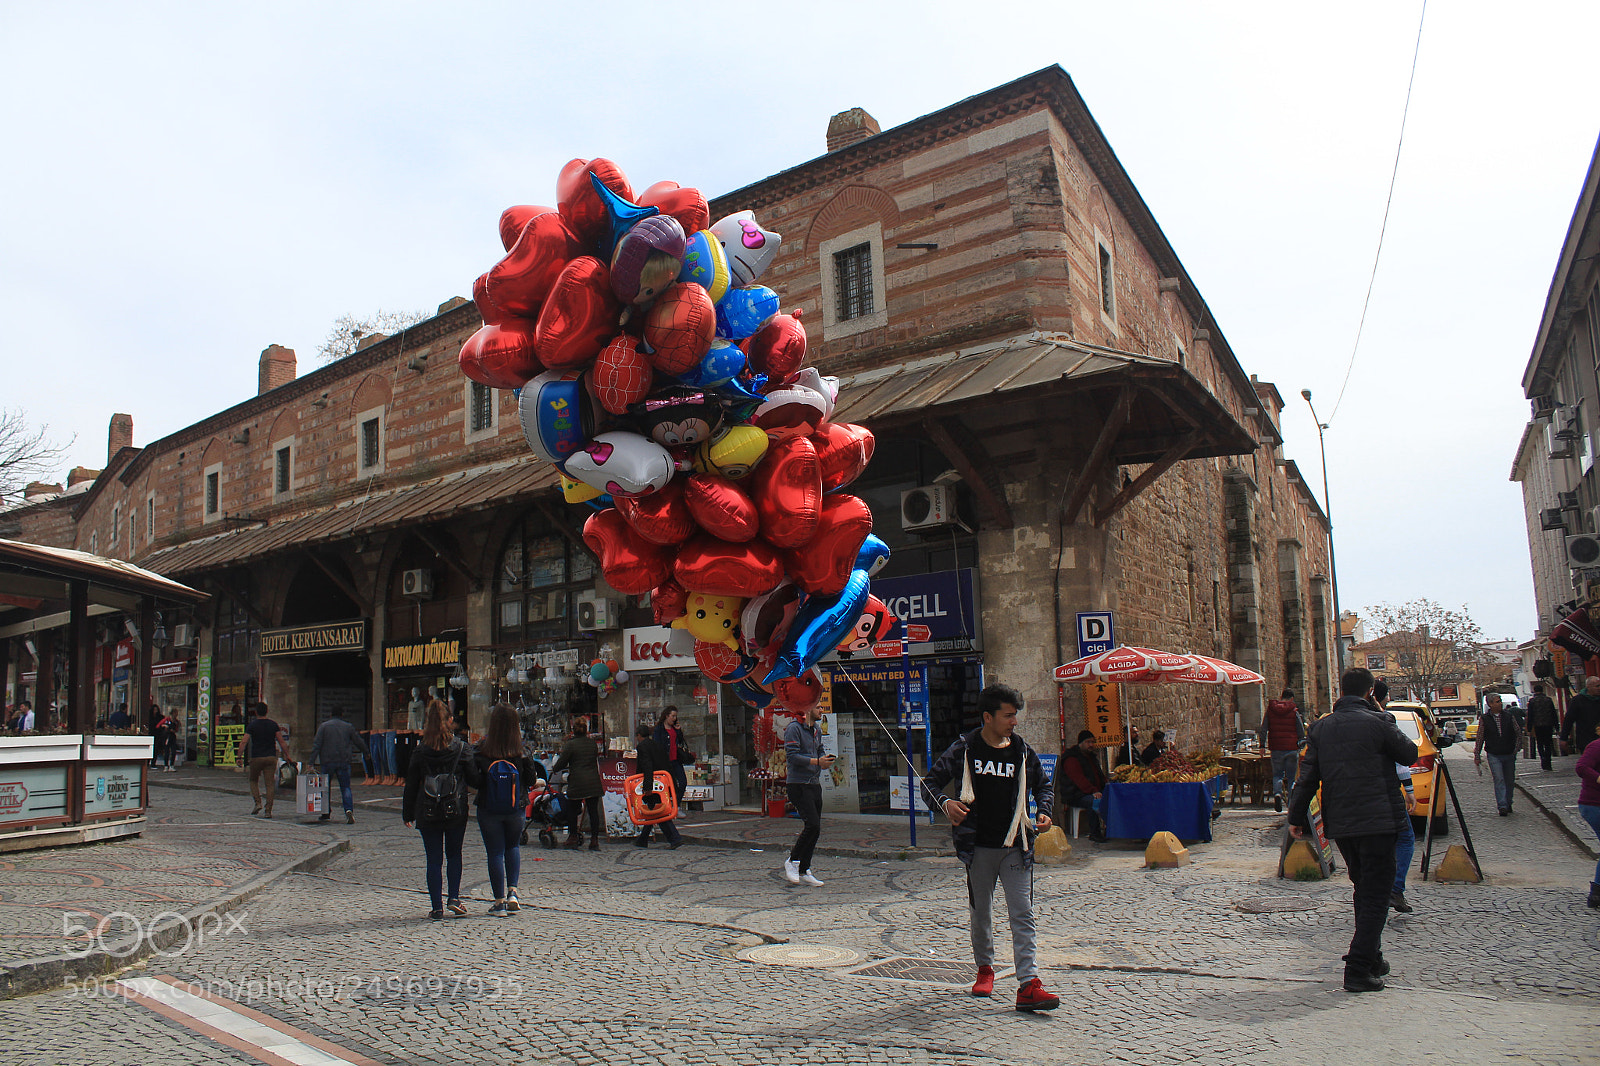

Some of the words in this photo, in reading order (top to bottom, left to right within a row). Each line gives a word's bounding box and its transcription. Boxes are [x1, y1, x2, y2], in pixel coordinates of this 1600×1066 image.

[881, 593, 948, 620] KCELL
[1086, 618, 1105, 639] D
[262, 633, 290, 653] HOTEL
[291, 626, 363, 649] KERVANSARAY
[385, 643, 424, 668] PANTOLON
[424, 637, 460, 665] DÜNYASI
[1086, 643, 1107, 653] cici
[1107, 661, 1137, 670] ALGIDA
[1161, 657, 1184, 665] ALGIDA
[833, 671, 871, 683] FATURALI
[871, 671, 889, 681] HAT
[888, 670, 921, 681] BEDVA
[1059, 667, 1080, 675] ALGIDA
